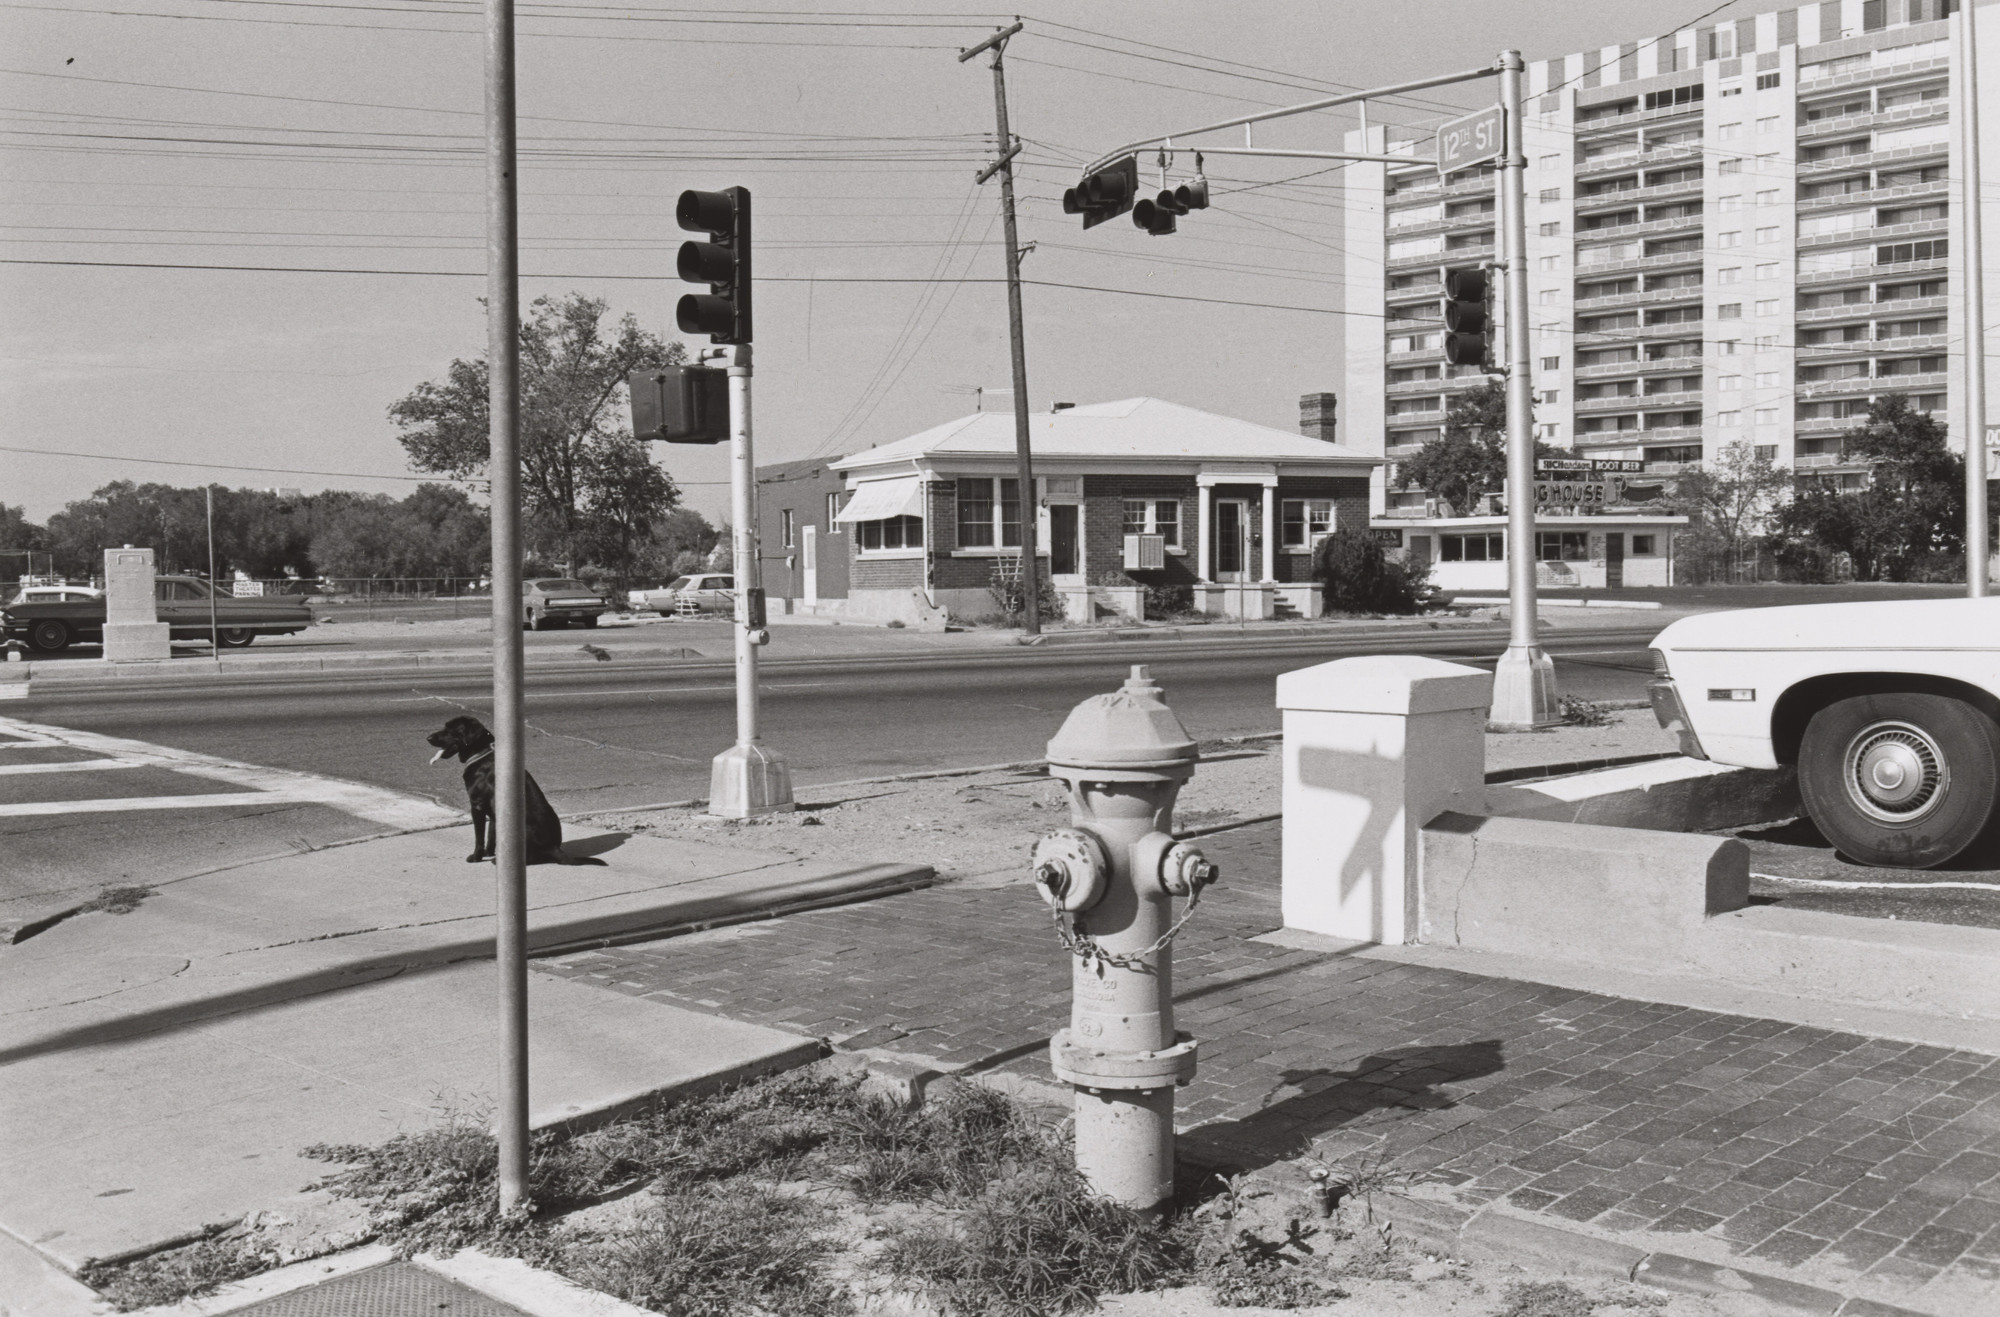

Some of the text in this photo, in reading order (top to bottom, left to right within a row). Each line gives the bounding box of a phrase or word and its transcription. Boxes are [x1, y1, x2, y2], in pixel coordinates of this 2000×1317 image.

[1443, 118, 1496, 162] 12TH ST
[1595, 460, 1620, 470] ROOT
[1622, 460, 1640, 471] BEER
[1552, 485, 1604, 502] HOUSE
[1367, 530, 1397, 540] OPEN
